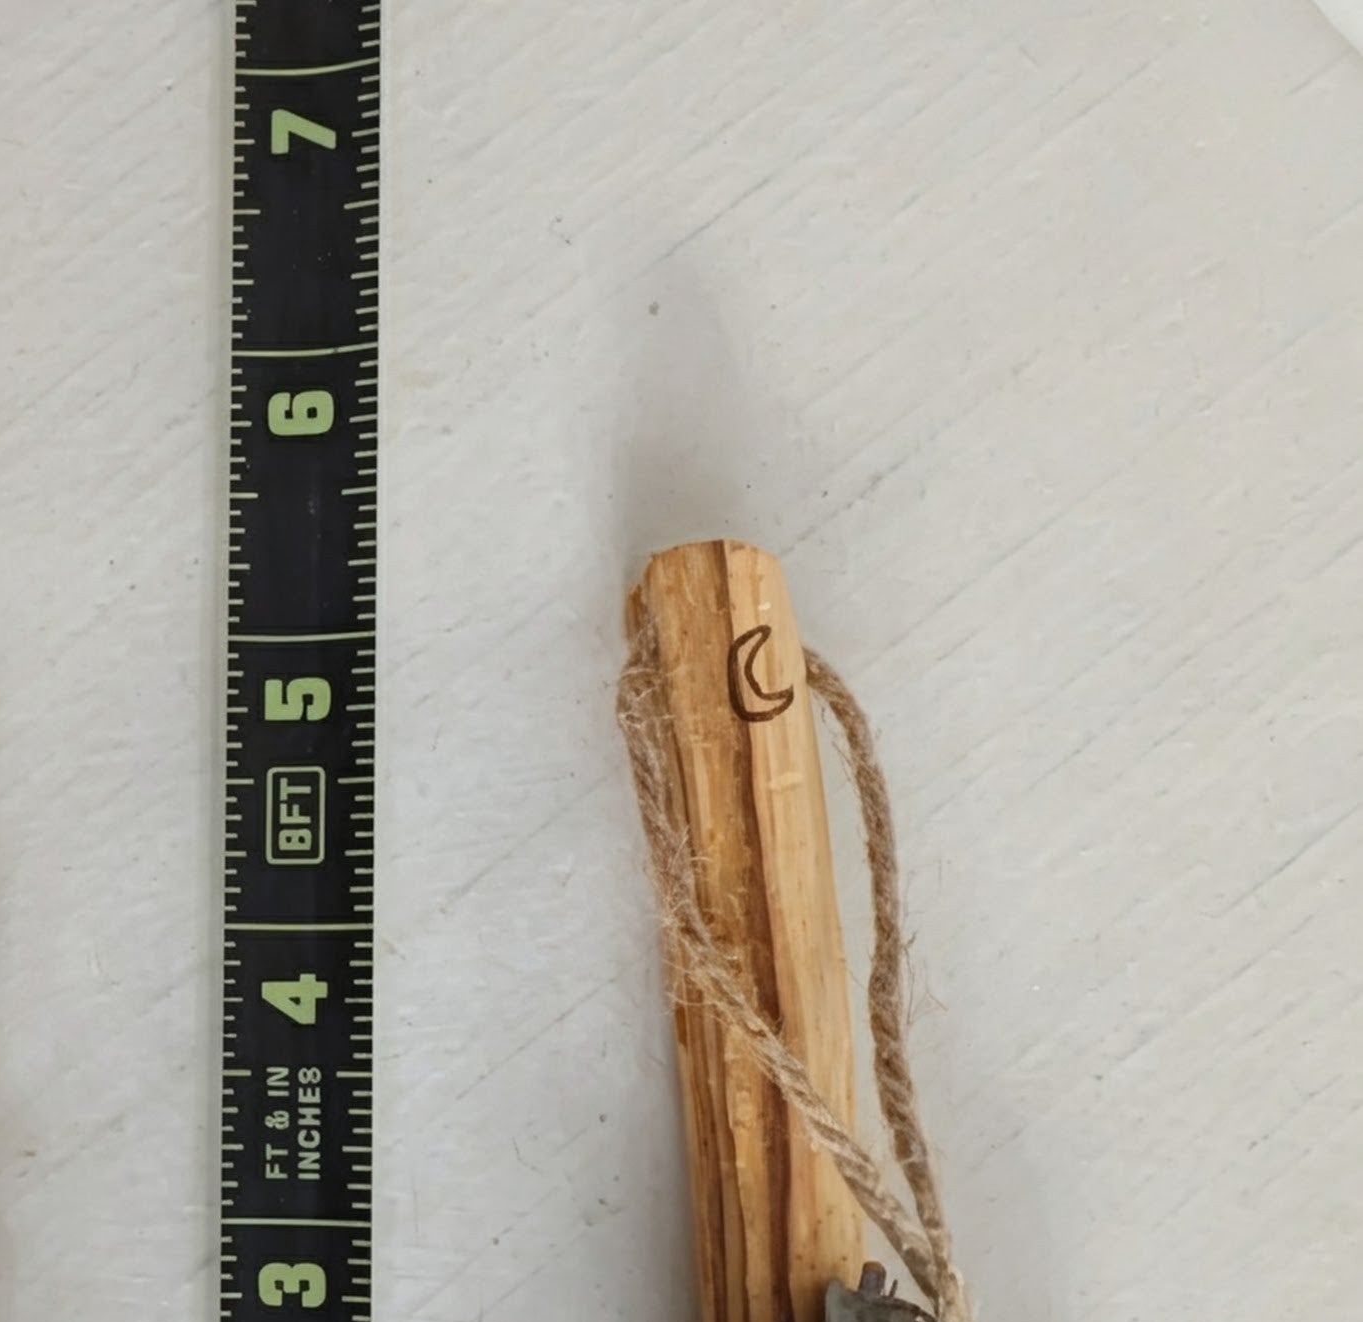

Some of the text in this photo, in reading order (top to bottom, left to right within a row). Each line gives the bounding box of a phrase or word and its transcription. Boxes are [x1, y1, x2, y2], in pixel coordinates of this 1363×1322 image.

[271, 108, 337, 154] 7
[267, 389, 335, 437] 6
[264, 675, 335, 723] 5
[261, 972, 329, 1025] 4
[264, 1066, 290, 1179] FT & IN
[297, 1066, 322, 1180] INCHES
[258, 1262, 326, 1308] 3
